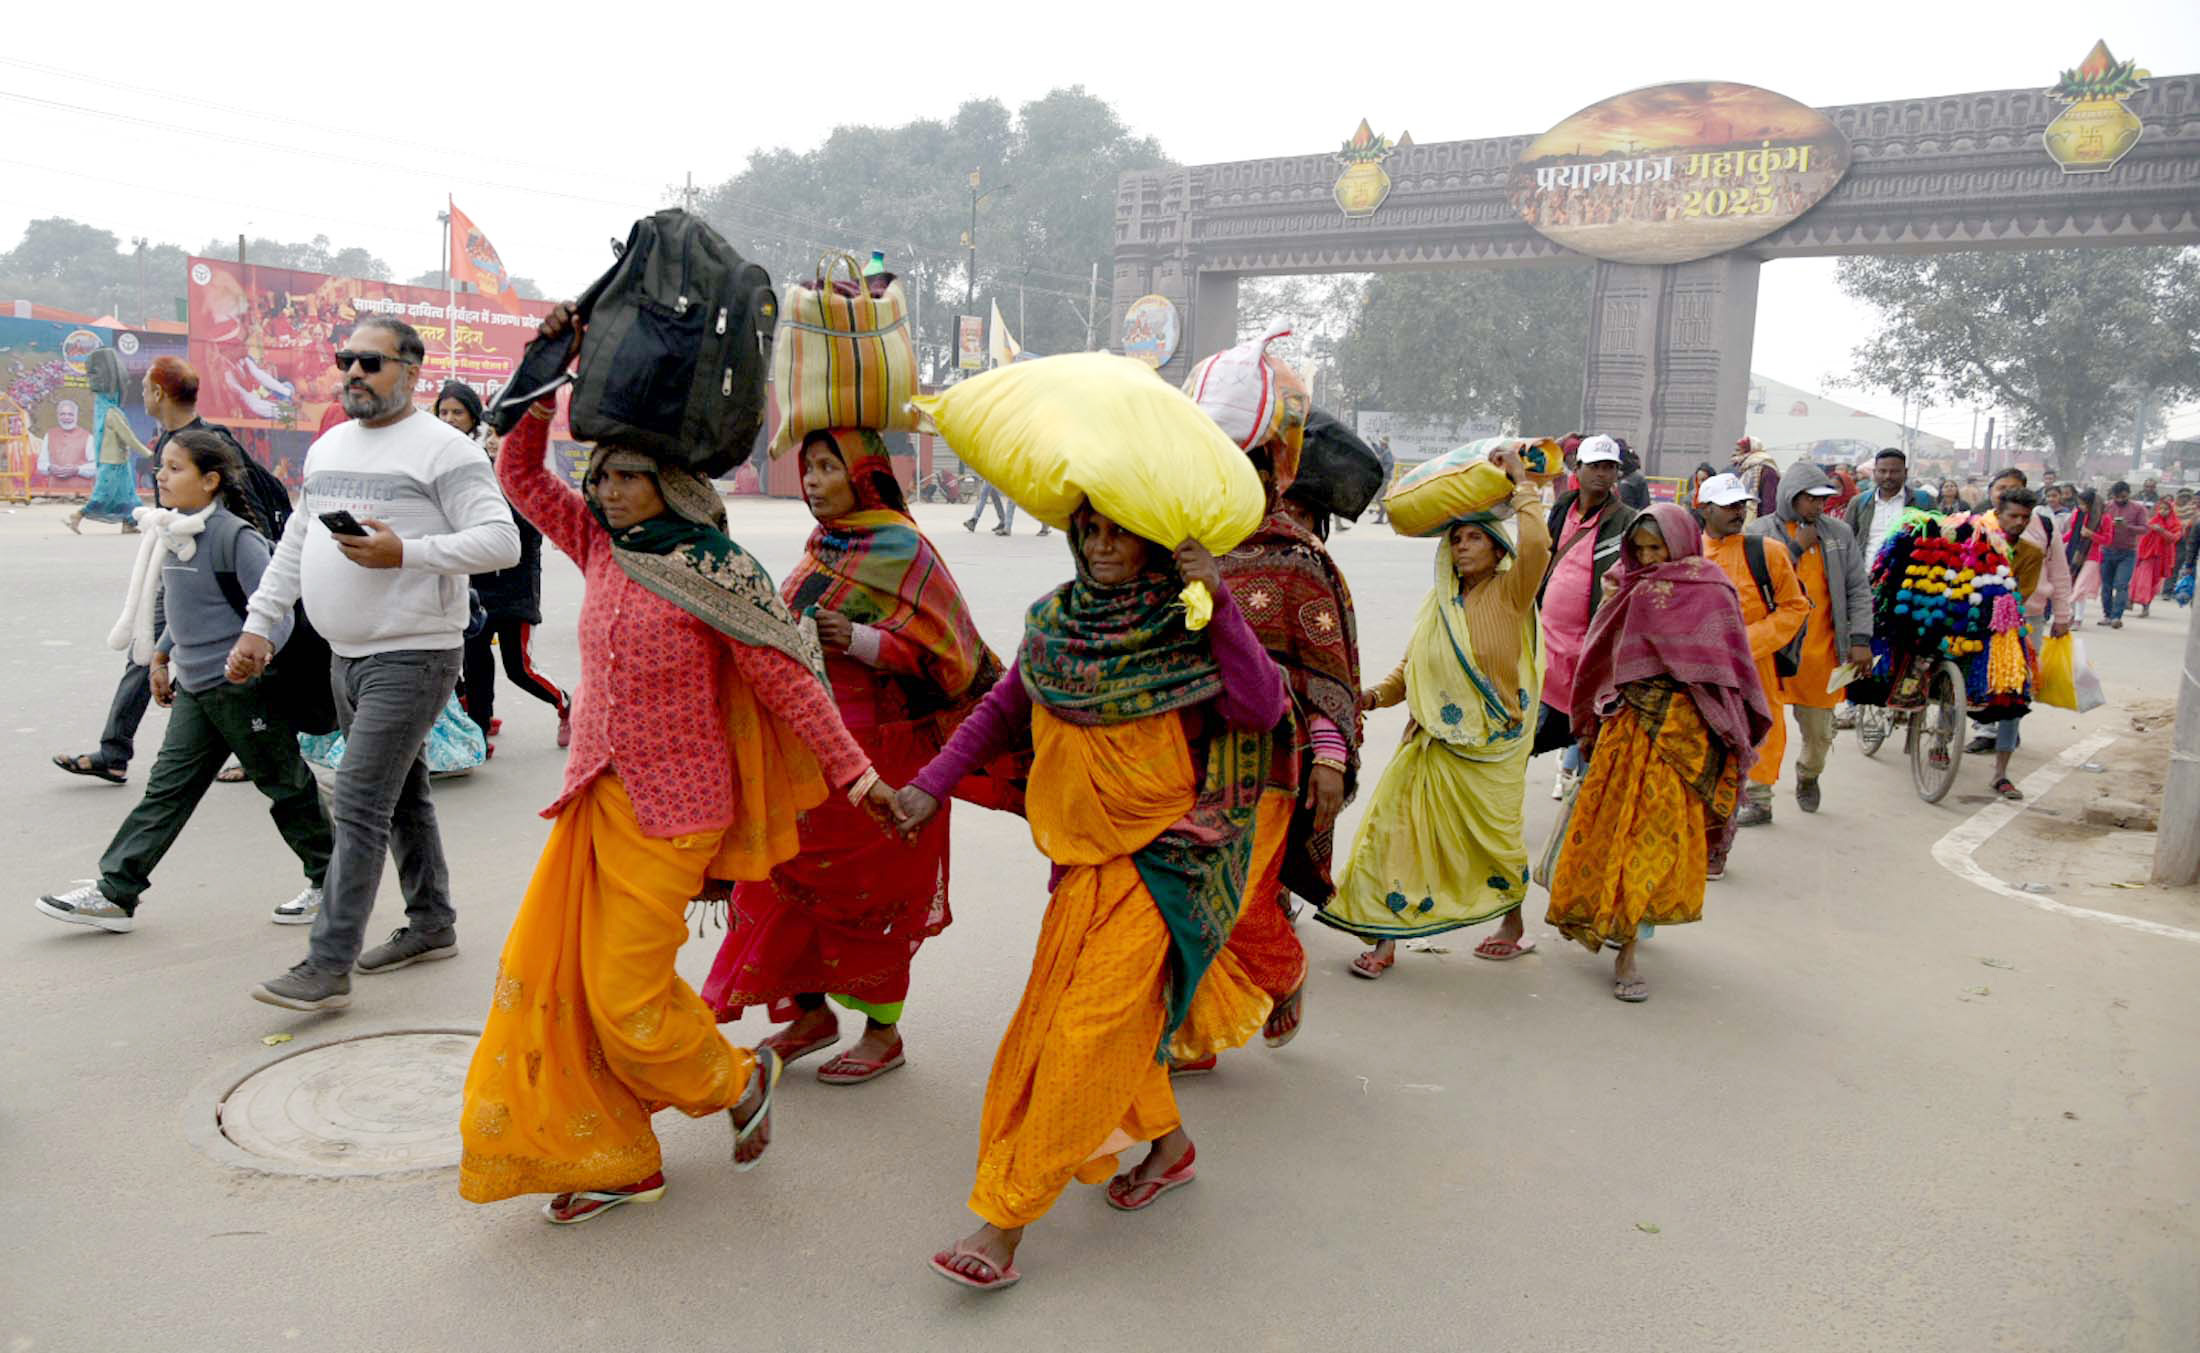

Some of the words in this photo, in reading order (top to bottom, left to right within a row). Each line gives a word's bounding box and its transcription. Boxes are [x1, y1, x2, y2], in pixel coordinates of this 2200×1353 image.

[1536, 156, 1673, 193] प्रयागराज
[1684, 140, 1814, 184] महाकुंभ
[1682, 186, 1776, 218] 2025
[352, 297, 406, 314] सामाजिक
[407, 301, 445, 318] दायित्व
